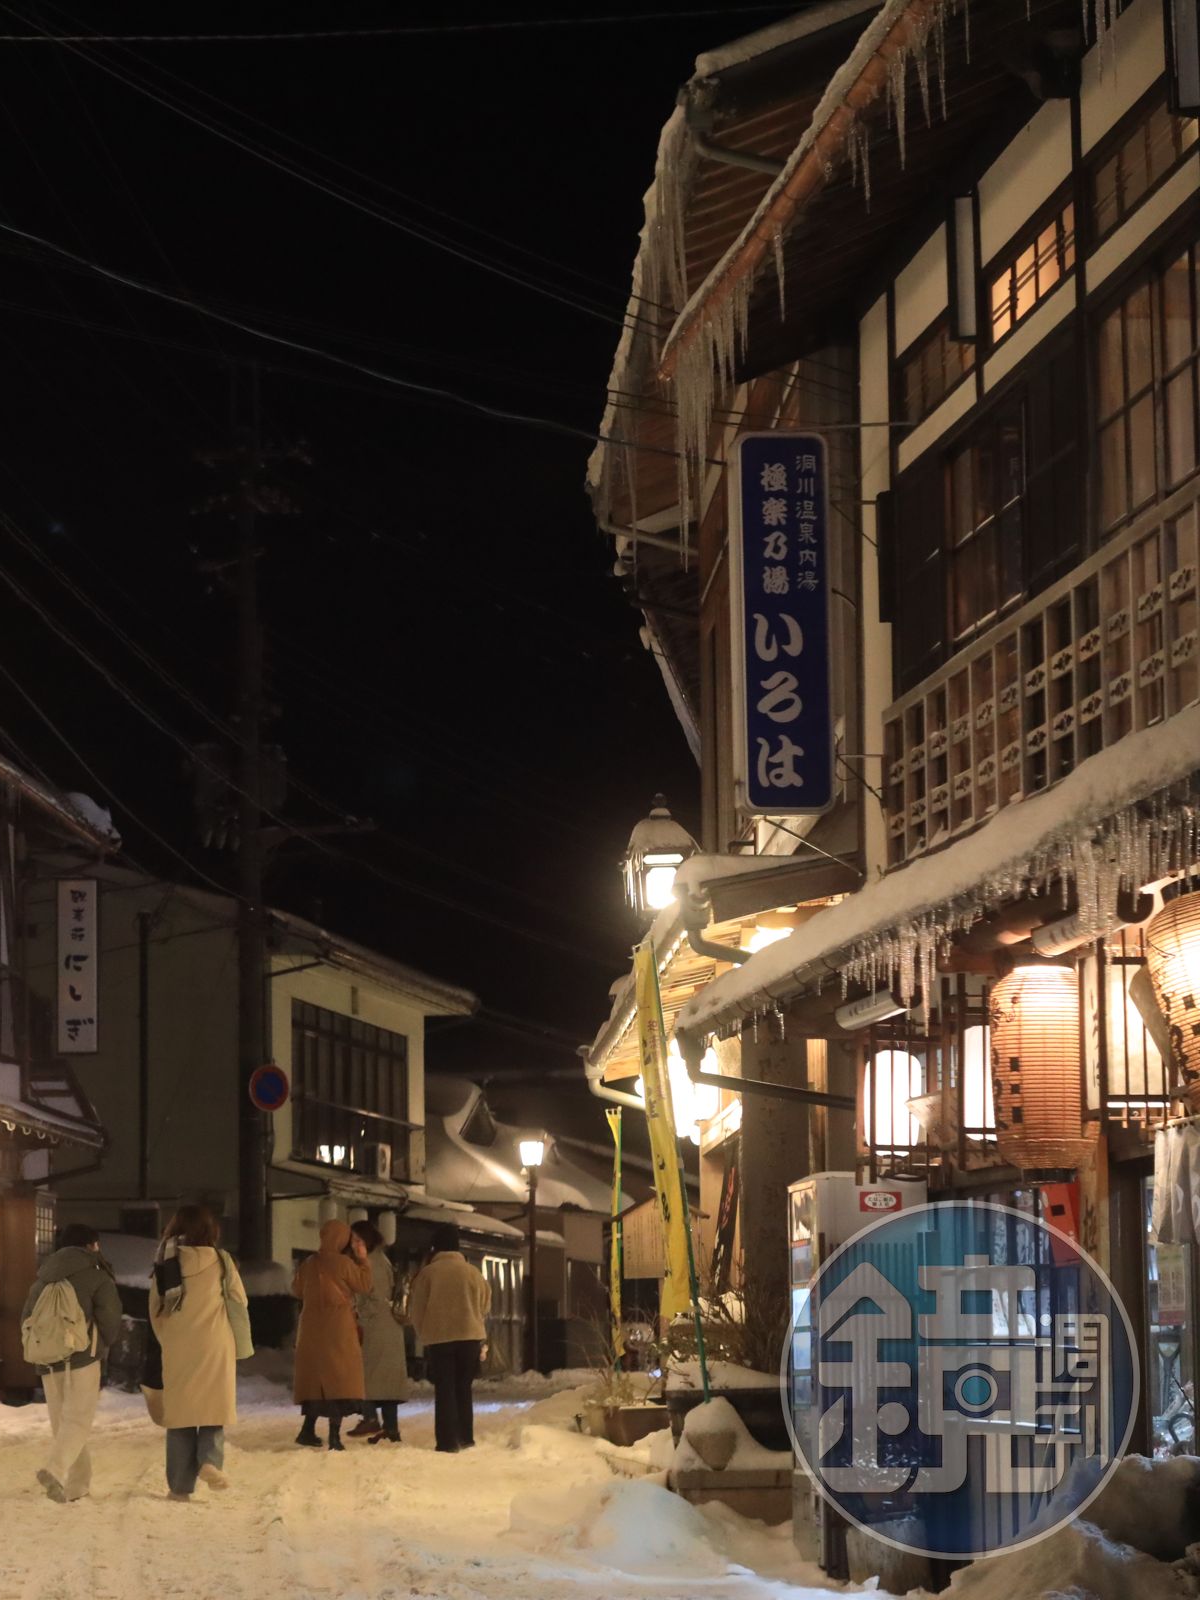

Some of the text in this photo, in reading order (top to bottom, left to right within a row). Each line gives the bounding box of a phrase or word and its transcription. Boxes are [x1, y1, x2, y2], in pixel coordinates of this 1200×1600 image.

[760, 462, 790, 595] 極楽乃湯
[796, 454, 819, 592] 洞川温泉内湯
[753, 613, 804, 788] いろは
